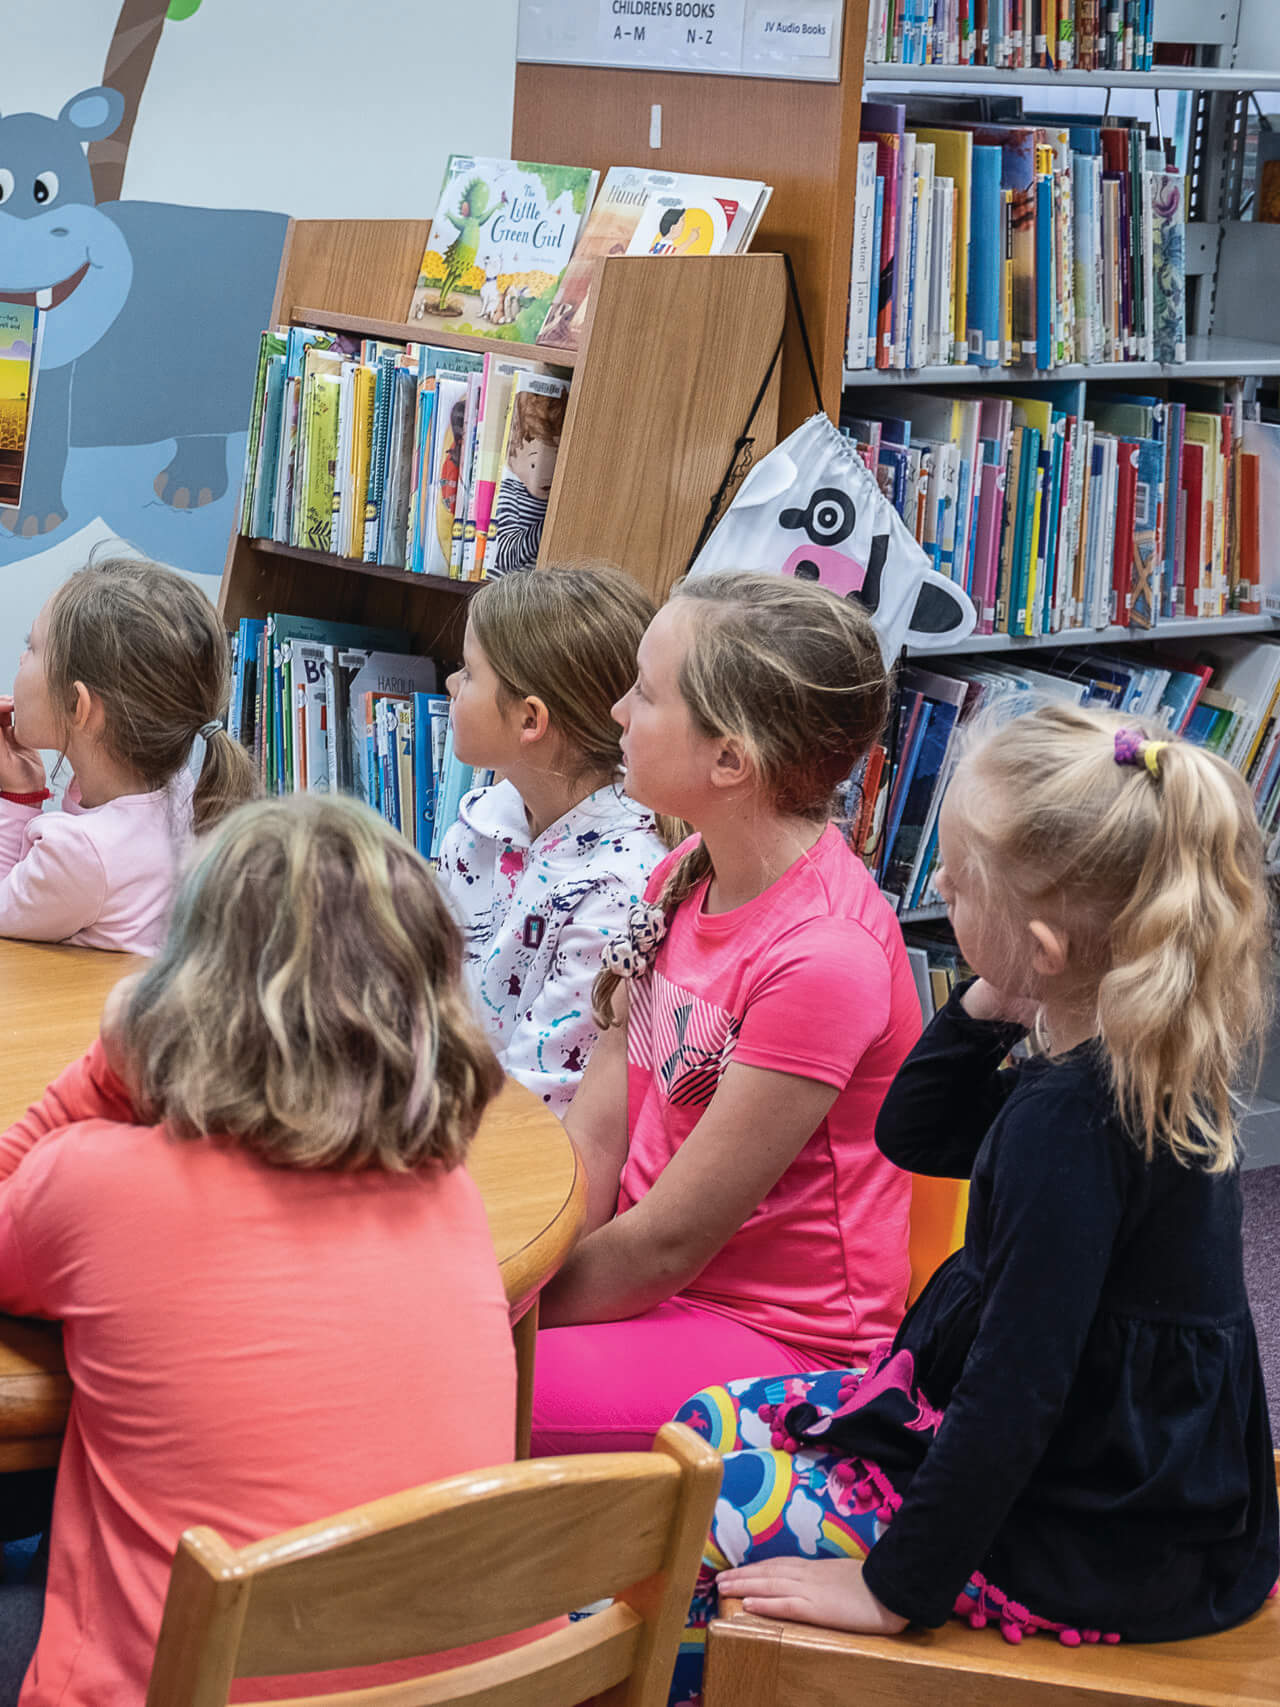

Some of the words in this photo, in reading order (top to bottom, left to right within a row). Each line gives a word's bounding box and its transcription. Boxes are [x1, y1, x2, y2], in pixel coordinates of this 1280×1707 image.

[612, 0, 672, 16] CHILDRENS
[675, 3, 715, 18] BOOKS
[765, 22, 774, 32] JV
[776, 22, 800, 33] Audio
[802, 24, 826, 35] Books
[524, 184, 536, 197] The
[510, 198, 541, 223] Little
[491, 215, 528, 243] Green
[533, 221, 565, 248] Girl
[858, 205, 870, 272] Snowtime
